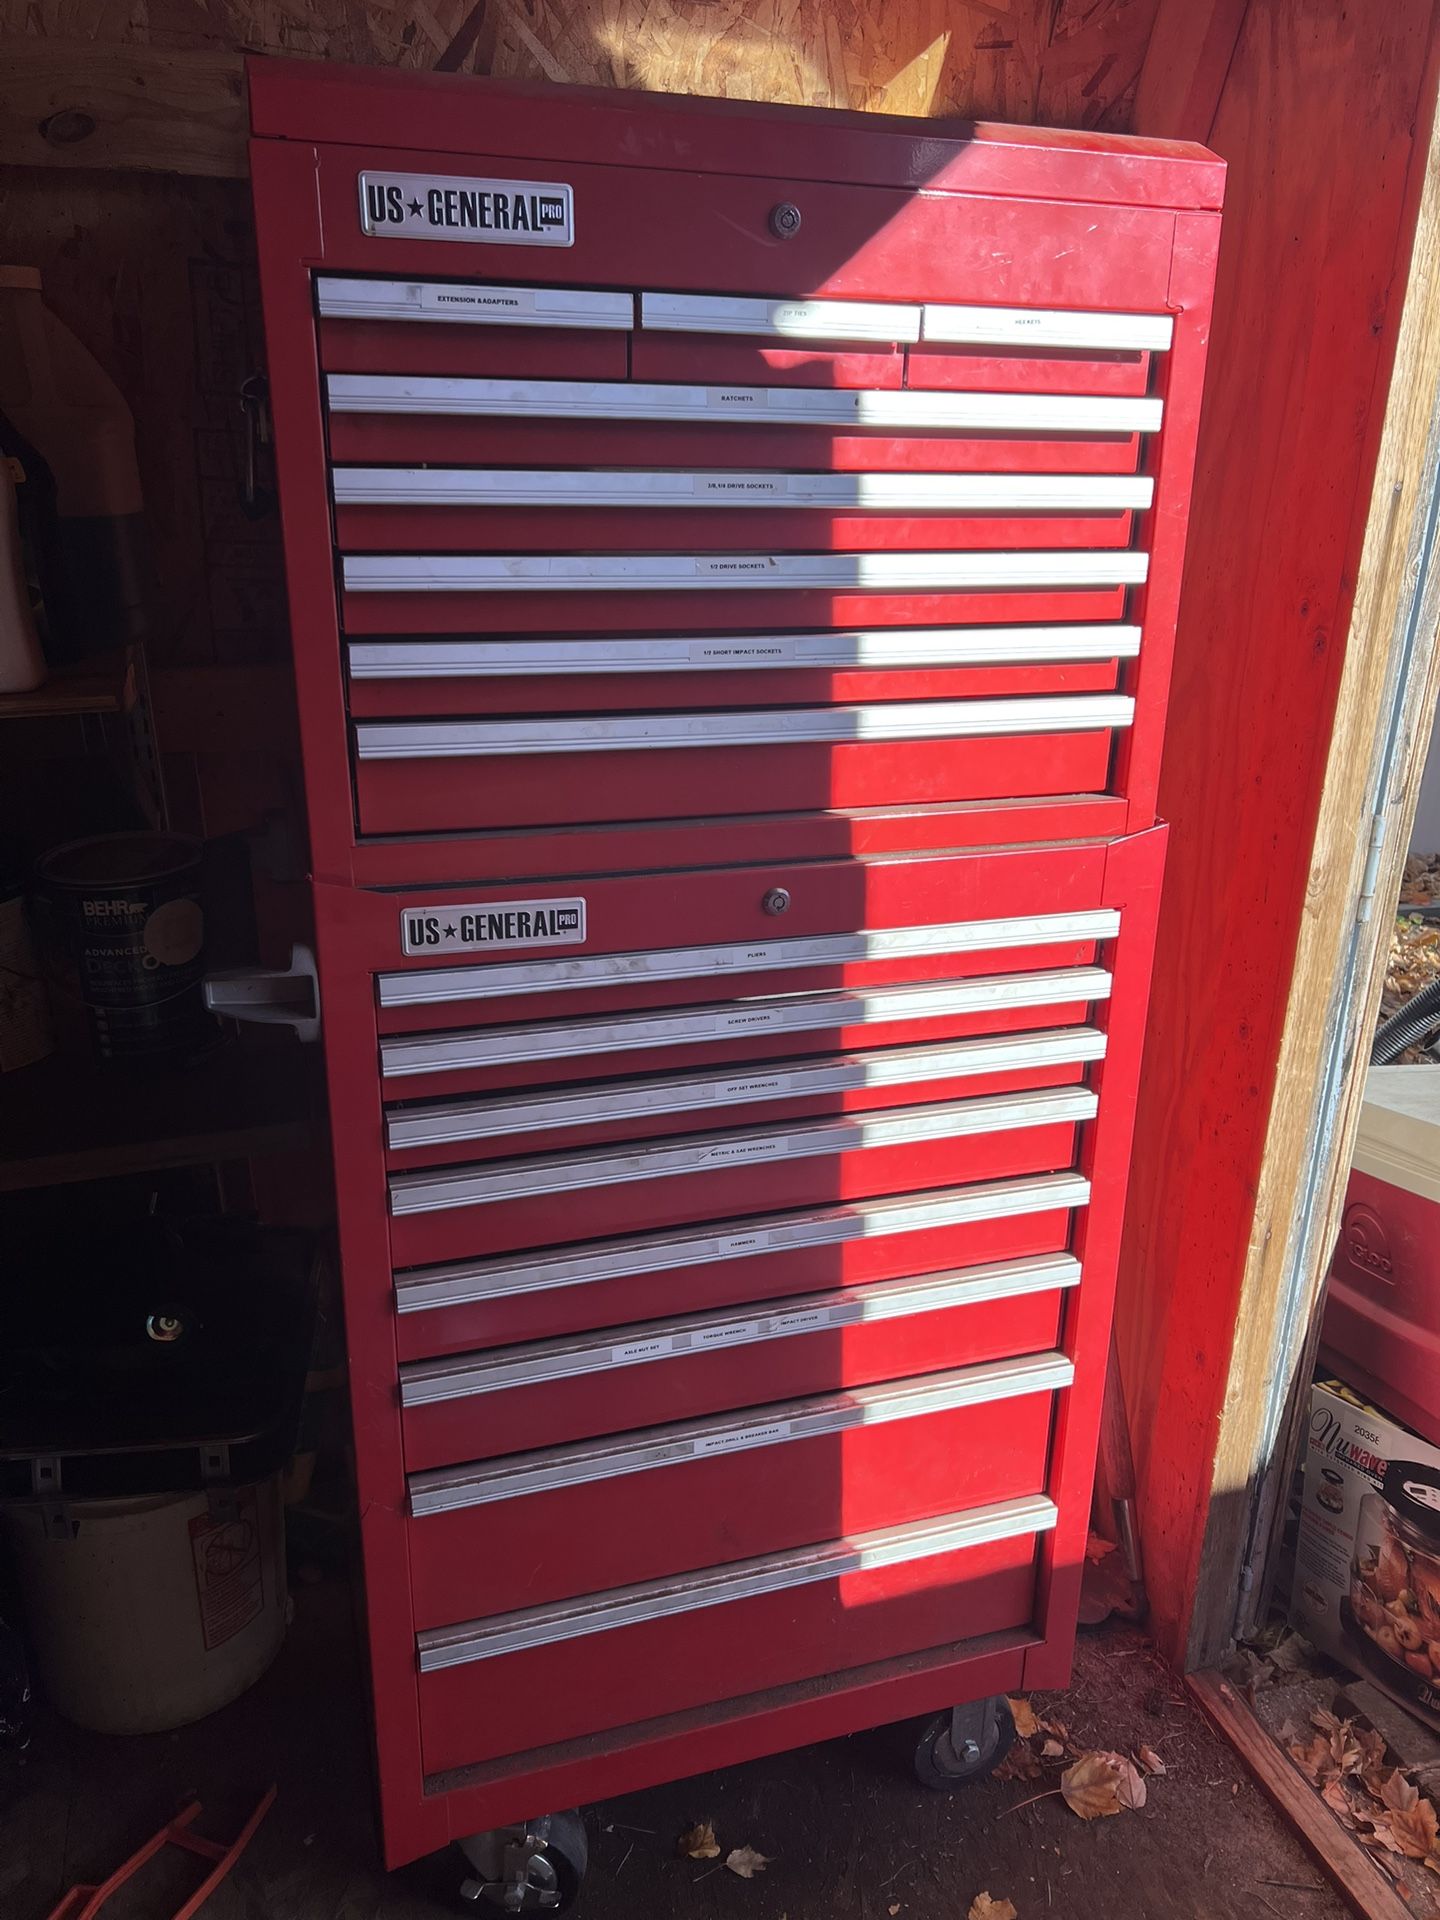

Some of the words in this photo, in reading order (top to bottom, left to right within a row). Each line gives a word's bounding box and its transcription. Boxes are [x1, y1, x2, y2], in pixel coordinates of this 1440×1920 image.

[367, 185, 404, 224] US
[427, 189, 544, 232] GENERAL
[540, 201, 563, 221] PRO
[437, 295, 476, 304] EXTENSION
[82, 900, 130, 917] BEHR
[409, 918, 440, 946] US
[460, 910, 561, 942] GENERAL
[558, 911, 578, 928] PRO
[84, 945, 149, 957] ADVANCED
[747, 1015, 770, 1023] DRIVERS
[749, 1081, 779, 1089] WRENCHES
[747, 1144, 776, 1152] WRENCHES
[780, 1318, 800, 1326] IMPACT
[703, 1332, 724, 1340] TORQUE
[724, 1328, 746, 1336] WRENCH
